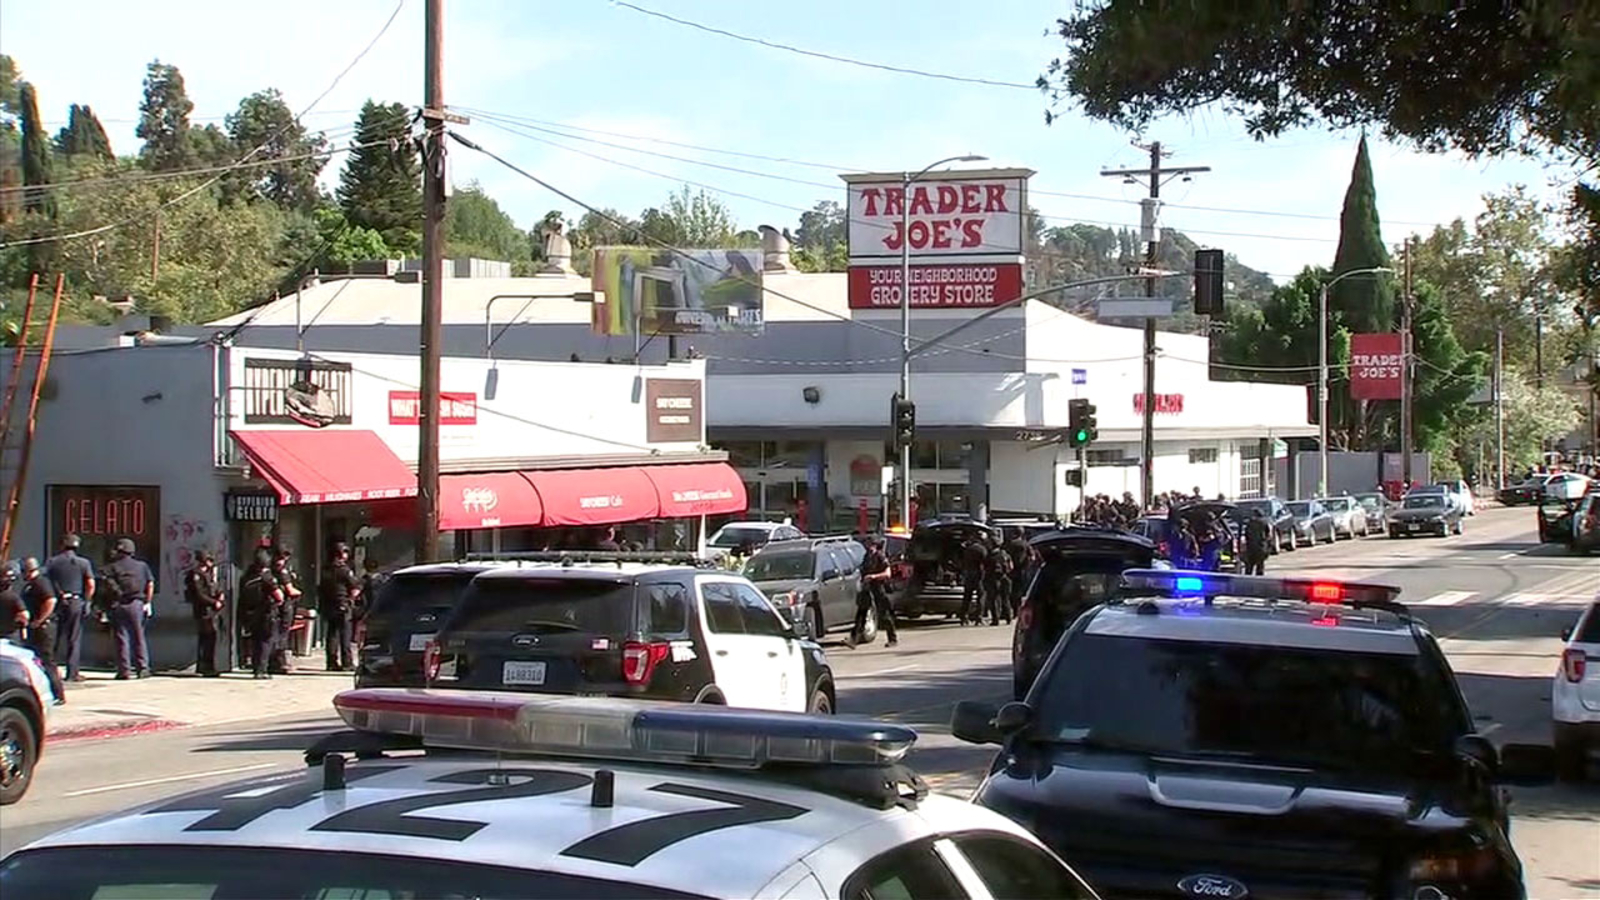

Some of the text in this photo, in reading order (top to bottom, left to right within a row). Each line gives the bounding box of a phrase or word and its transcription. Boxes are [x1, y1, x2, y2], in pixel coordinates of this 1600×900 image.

[860, 184, 1009, 217] TRADER
[882, 218, 985, 250] JOE'S
[870, 269, 902, 283] YOUR
[871, 284, 995, 304] GROERY STORE
[1359, 366, 1400, 378] JOE'S
[66, 499, 145, 534] GELATO
[140, 765, 812, 867] 427
[1193, 877, 1233, 896] Ford
